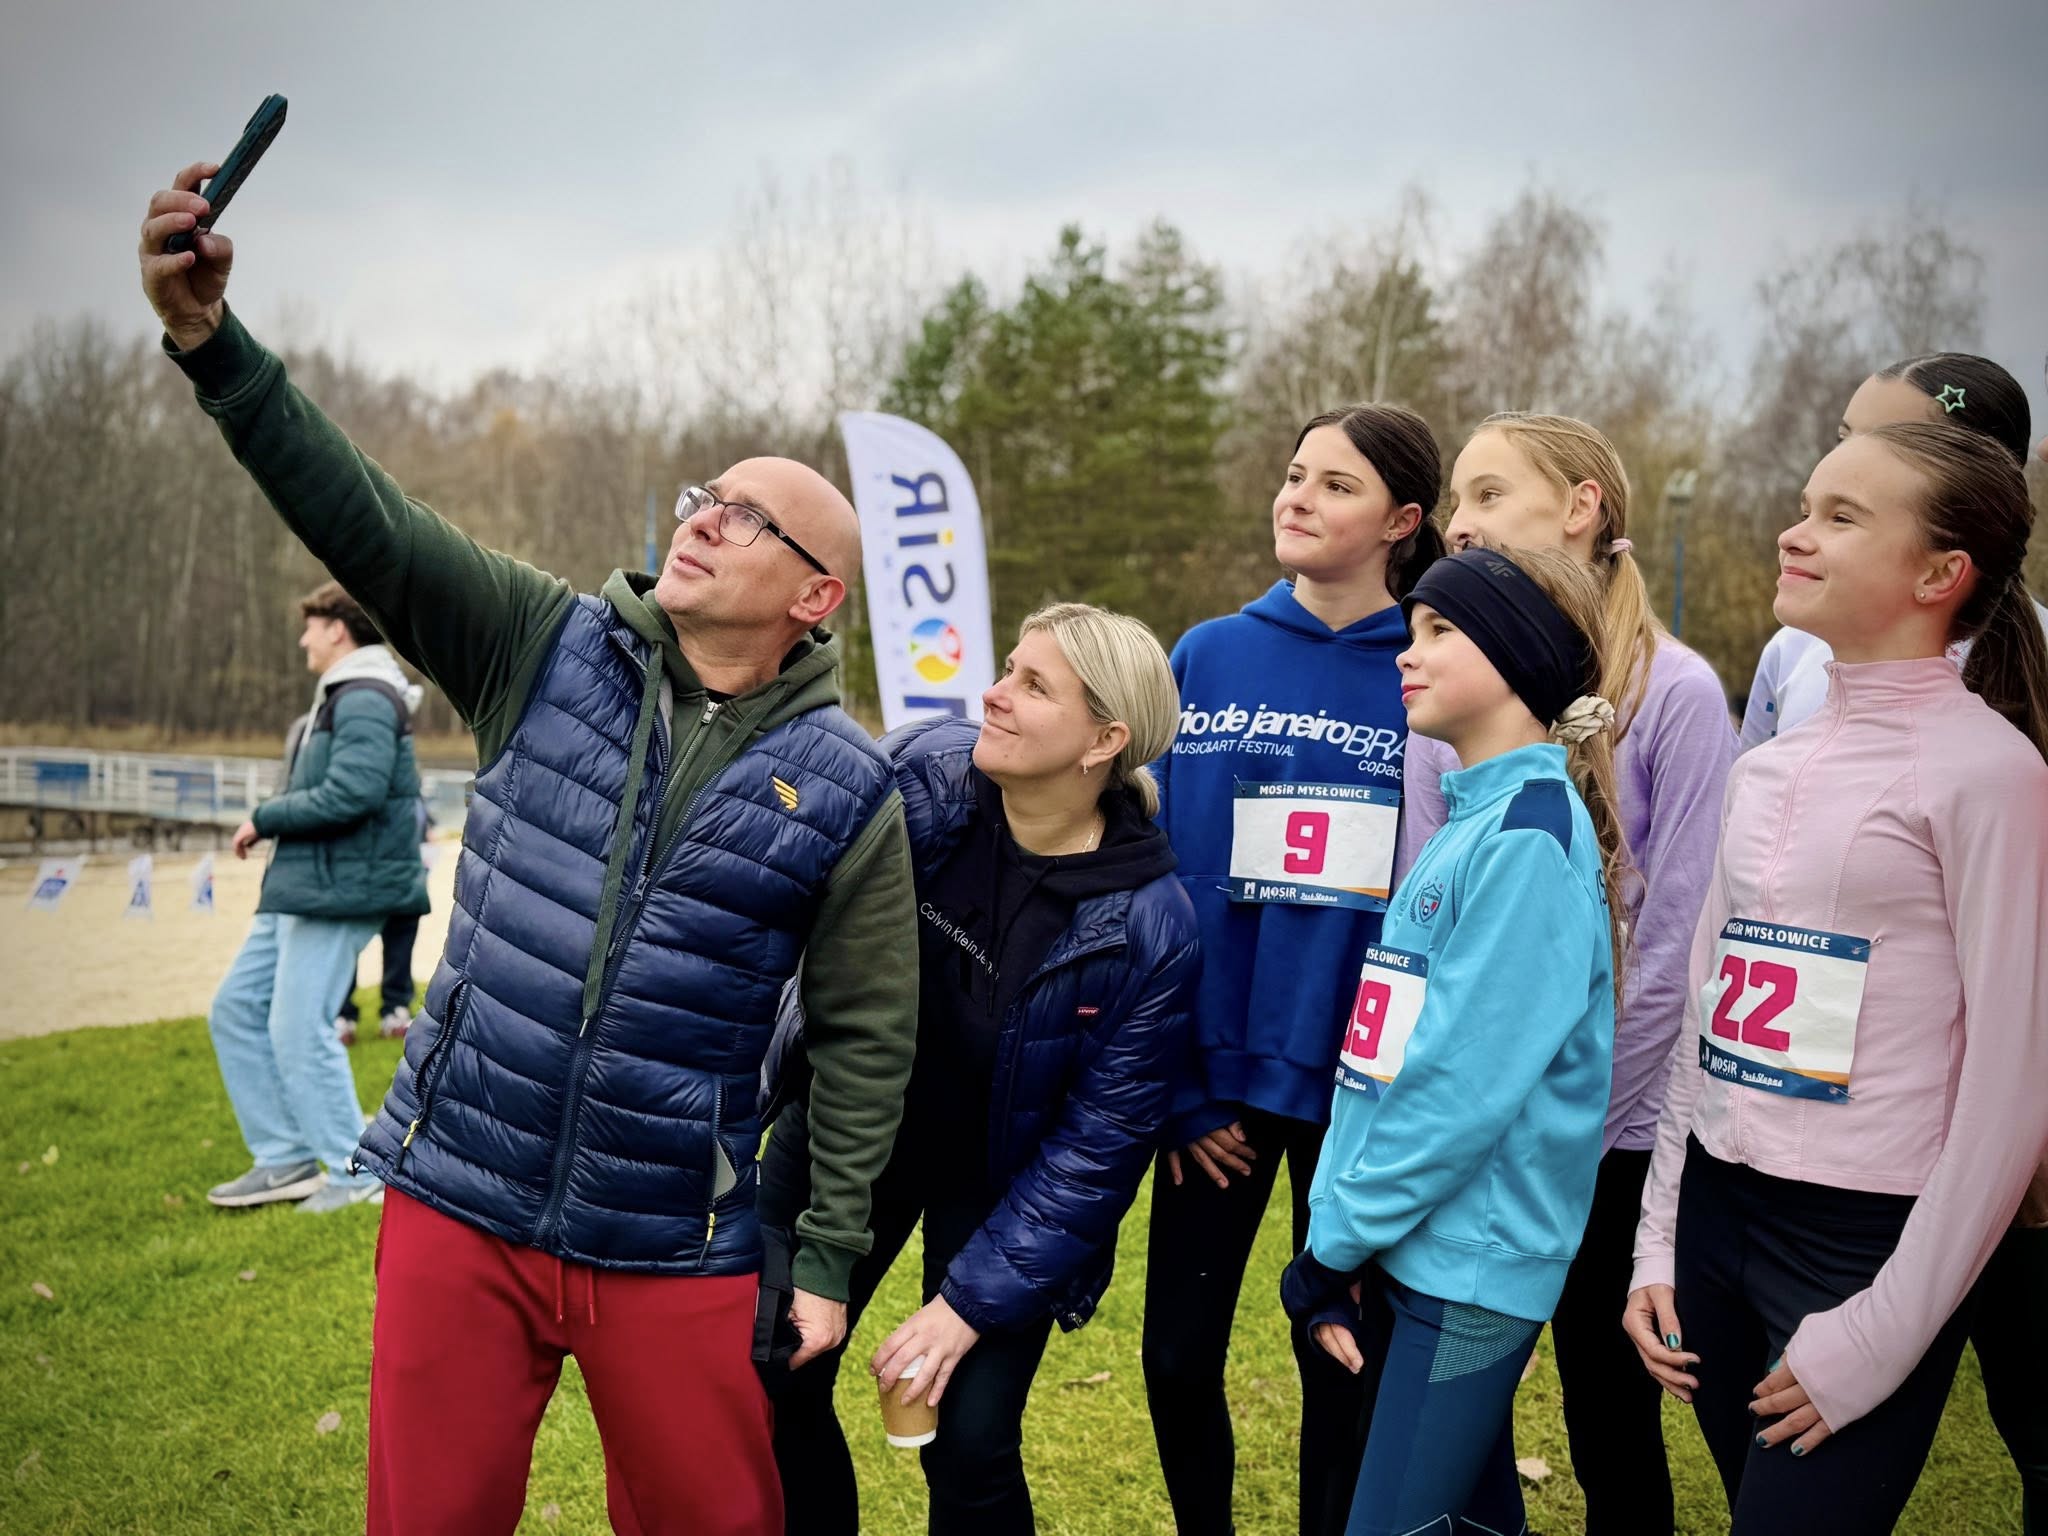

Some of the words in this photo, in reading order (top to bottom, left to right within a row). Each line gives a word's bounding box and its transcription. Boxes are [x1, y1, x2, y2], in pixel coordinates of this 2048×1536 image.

[1211, 703, 1249, 733] de
[1237, 741, 1295, 757] FESTIVAL
[1297, 785, 1371, 800] MYSŁOWICE
[1283, 811, 1330, 875] 9
[920, 902, 953, 935] Calvin
[951, 926, 978, 954] Klein
[1744, 925, 1831, 950] MYSŁOWICE
[1711, 954, 1798, 1053] 22
